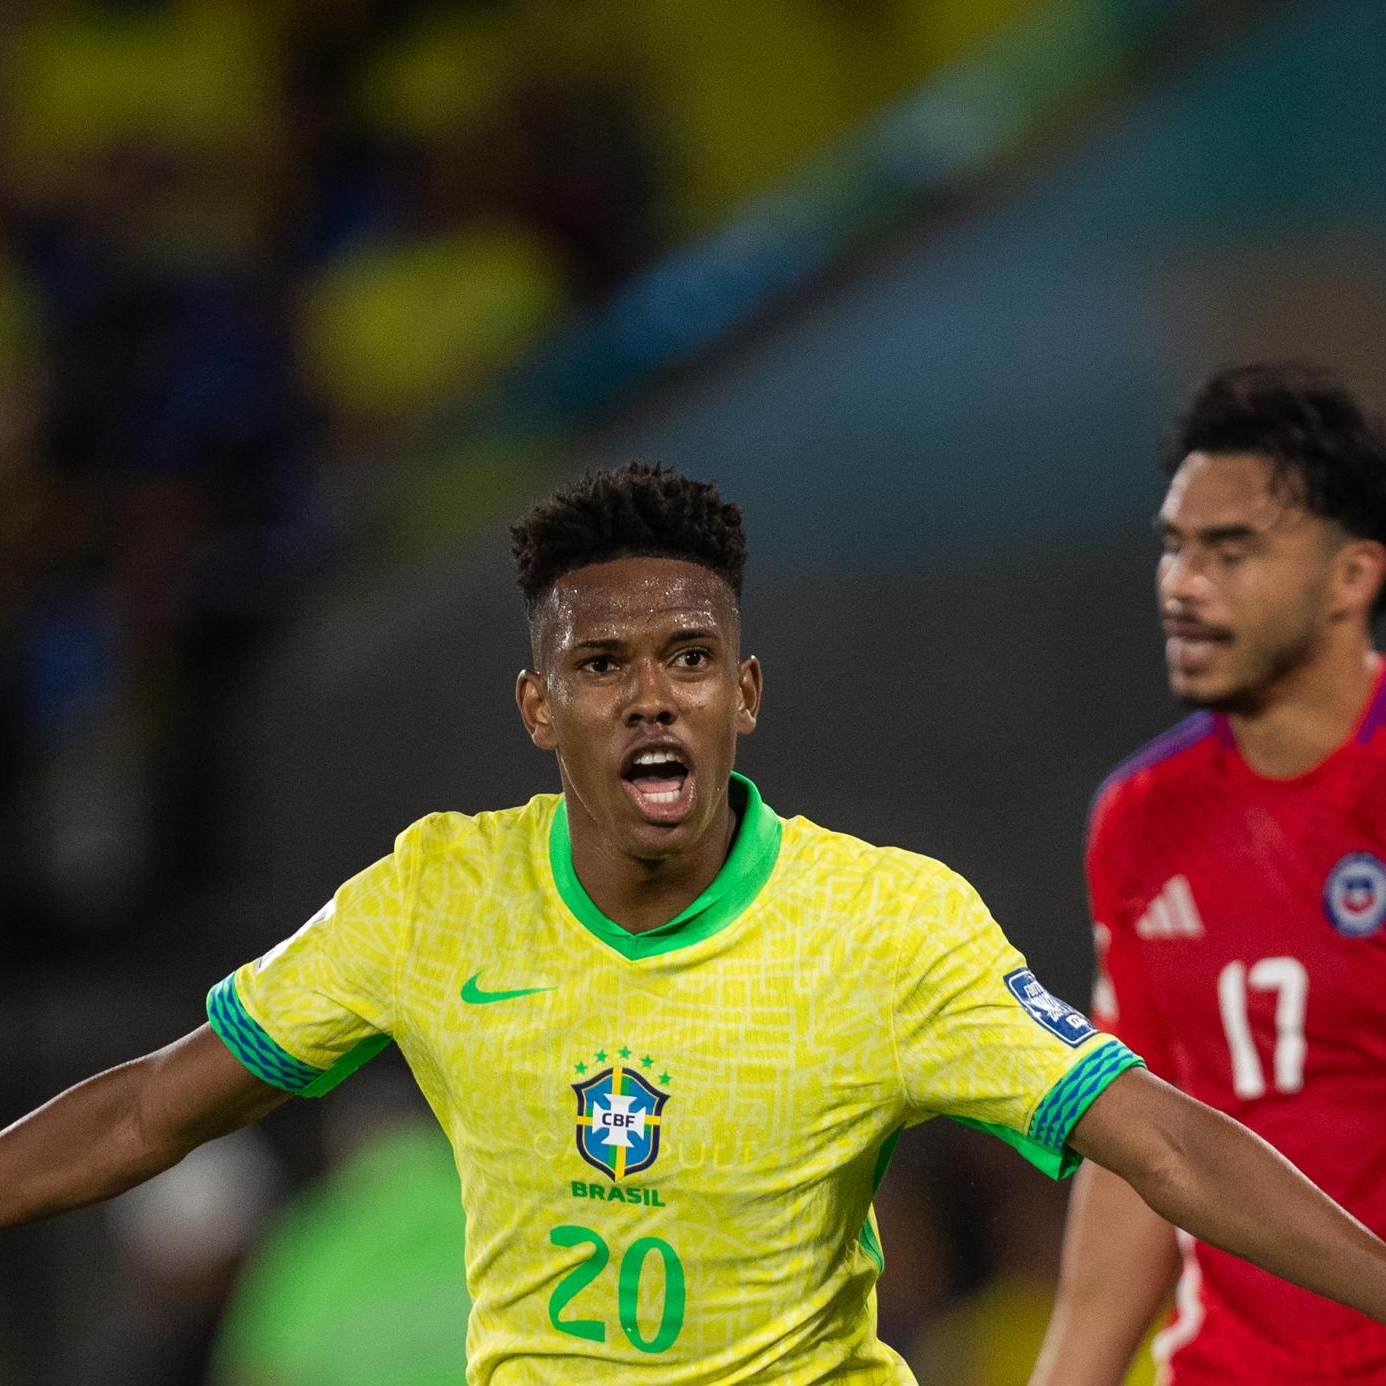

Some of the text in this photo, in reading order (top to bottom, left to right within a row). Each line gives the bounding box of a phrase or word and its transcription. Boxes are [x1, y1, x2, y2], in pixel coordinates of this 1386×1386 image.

[1217, 956, 1310, 1100] 17
[602, 1112, 636, 1128] CBF
[571, 1180, 666, 1208] BRASIL
[548, 1224, 686, 1354] 20
